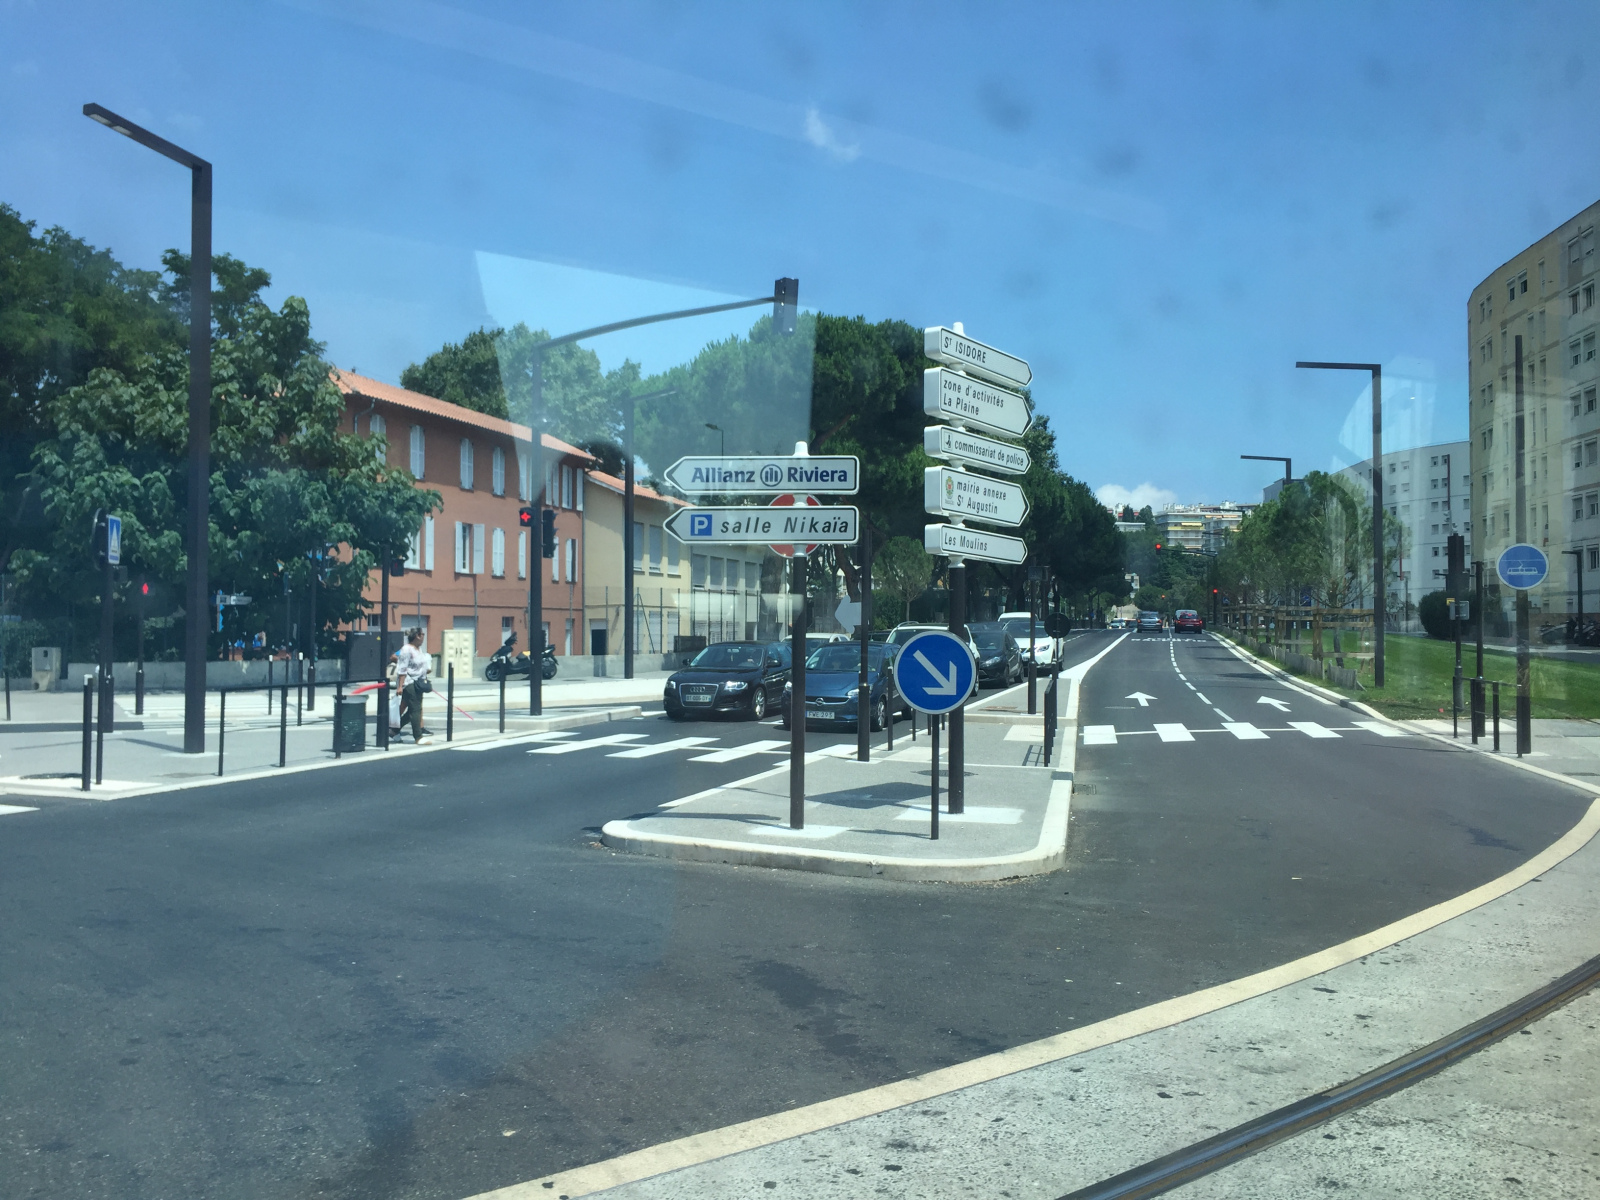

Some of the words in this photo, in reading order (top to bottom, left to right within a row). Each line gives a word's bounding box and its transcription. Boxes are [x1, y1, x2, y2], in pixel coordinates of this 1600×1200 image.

[955, 340, 987, 363] ISIDORE
[943, 379, 962, 393] zone
[965, 384, 1004, 408] d'activités
[943, 393, 952, 406] La
[955, 396, 980, 416] Plaine
[954, 440, 996, 459] commissariat
[997, 449, 1005, 462] de
[1005, 452, 1024, 466] police
[691, 467, 755, 483] Allianz
[787, 466, 848, 483] Riviera
[956, 480, 980, 495] mairie
[983, 485, 1007, 501] annexe
[966, 496, 998, 514] Augustin
[720, 517, 771, 534] salle
[784, 516, 849, 534] Nikaïa
[944, 532, 956, 546] Les
[960, 535, 988, 551] Moulins
